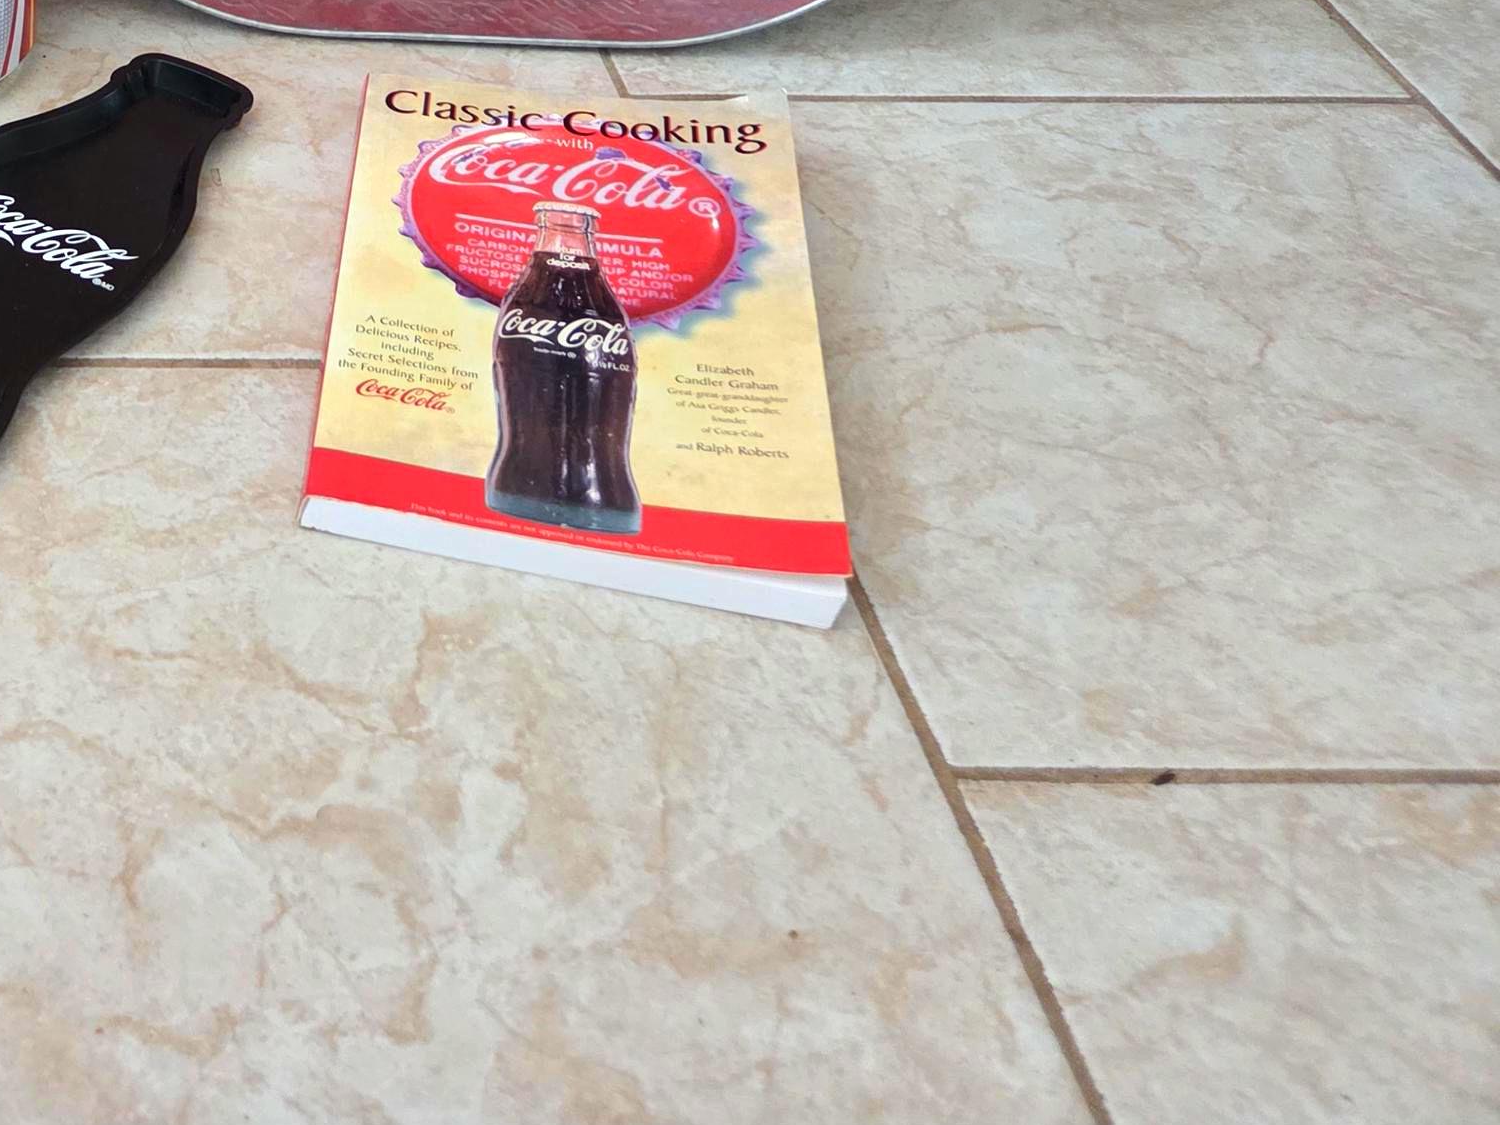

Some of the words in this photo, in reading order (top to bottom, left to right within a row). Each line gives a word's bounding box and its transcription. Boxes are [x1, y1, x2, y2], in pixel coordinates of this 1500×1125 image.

[385, 89, 542, 132] Classic
[563, 111, 768, 155] Cooking
[553, 137, 595, 151] with
[428, 143, 694, 210] Coca-Cola
[454, 222, 537, 243] ORIGINA
[595, 241, 663, 258] MULA
[467, 238, 533, 254] CARBON
[445, 244, 523, 263] FRUCTOSE
[458, 265, 520, 279] PHOSPH
[459, 255, 527, 272] SUCROS
[355, 324, 410, 342] Delicious
[365, 314, 377, 324] A
[379, 315, 439, 336] Collection
[442, 328, 455, 338] of
[500, 308, 629, 355] Coca-Cola
[381, 341, 435, 361] including
[347, 348, 384, 362] Secret
[388, 353, 448, 374] Selections
[451, 366, 479, 380] from
[696, 363, 755, 376] Elizabeth
[338, 359, 358, 370] the
[361, 362, 415, 383] Founding
[419, 373, 457, 391] Family
[460, 380, 474, 391] of
[675, 374, 725, 387] Candler
[728, 379, 779, 391] Graham
[356, 378, 452, 412] Coca-Cola
[695, 441, 734, 456] Ralph
[737, 445, 790, 459] Roberts
